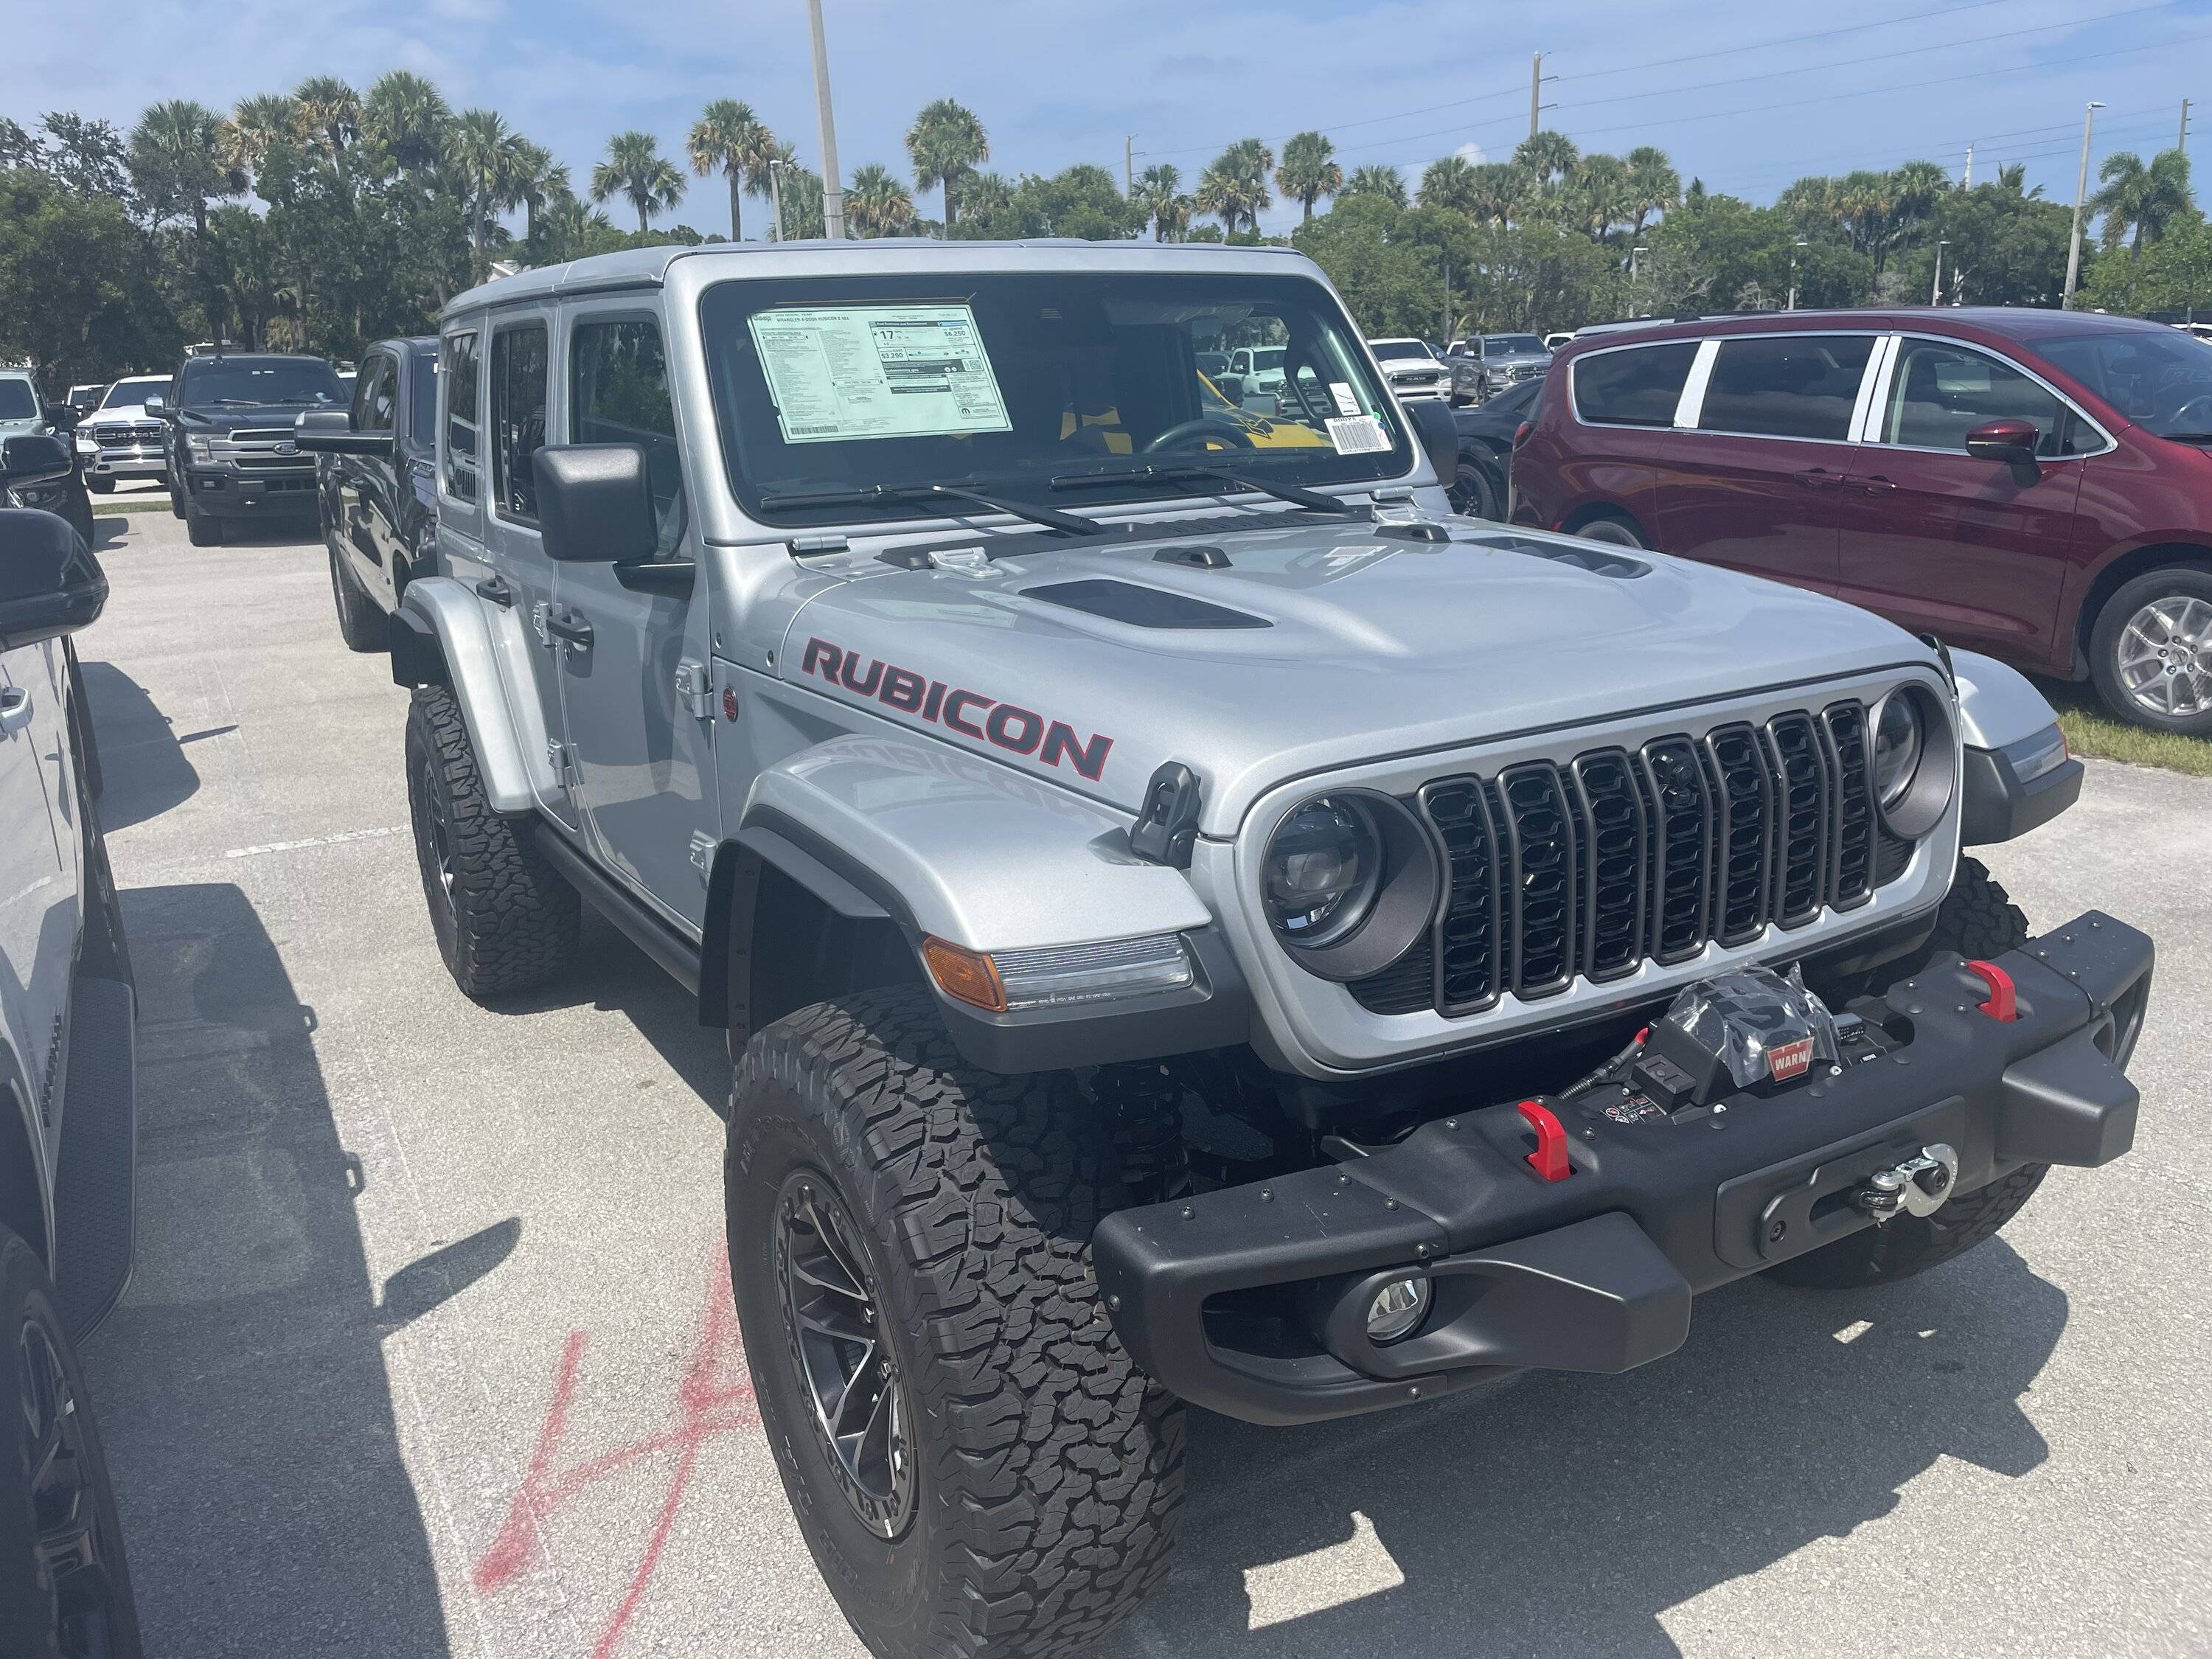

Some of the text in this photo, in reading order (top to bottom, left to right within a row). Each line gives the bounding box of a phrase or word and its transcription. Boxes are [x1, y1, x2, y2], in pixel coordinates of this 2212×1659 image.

[880, 330, 894, 340] 17
[801, 636, 1114, 782] RUBICON
[1775, 1051, 1807, 1071] WARN
